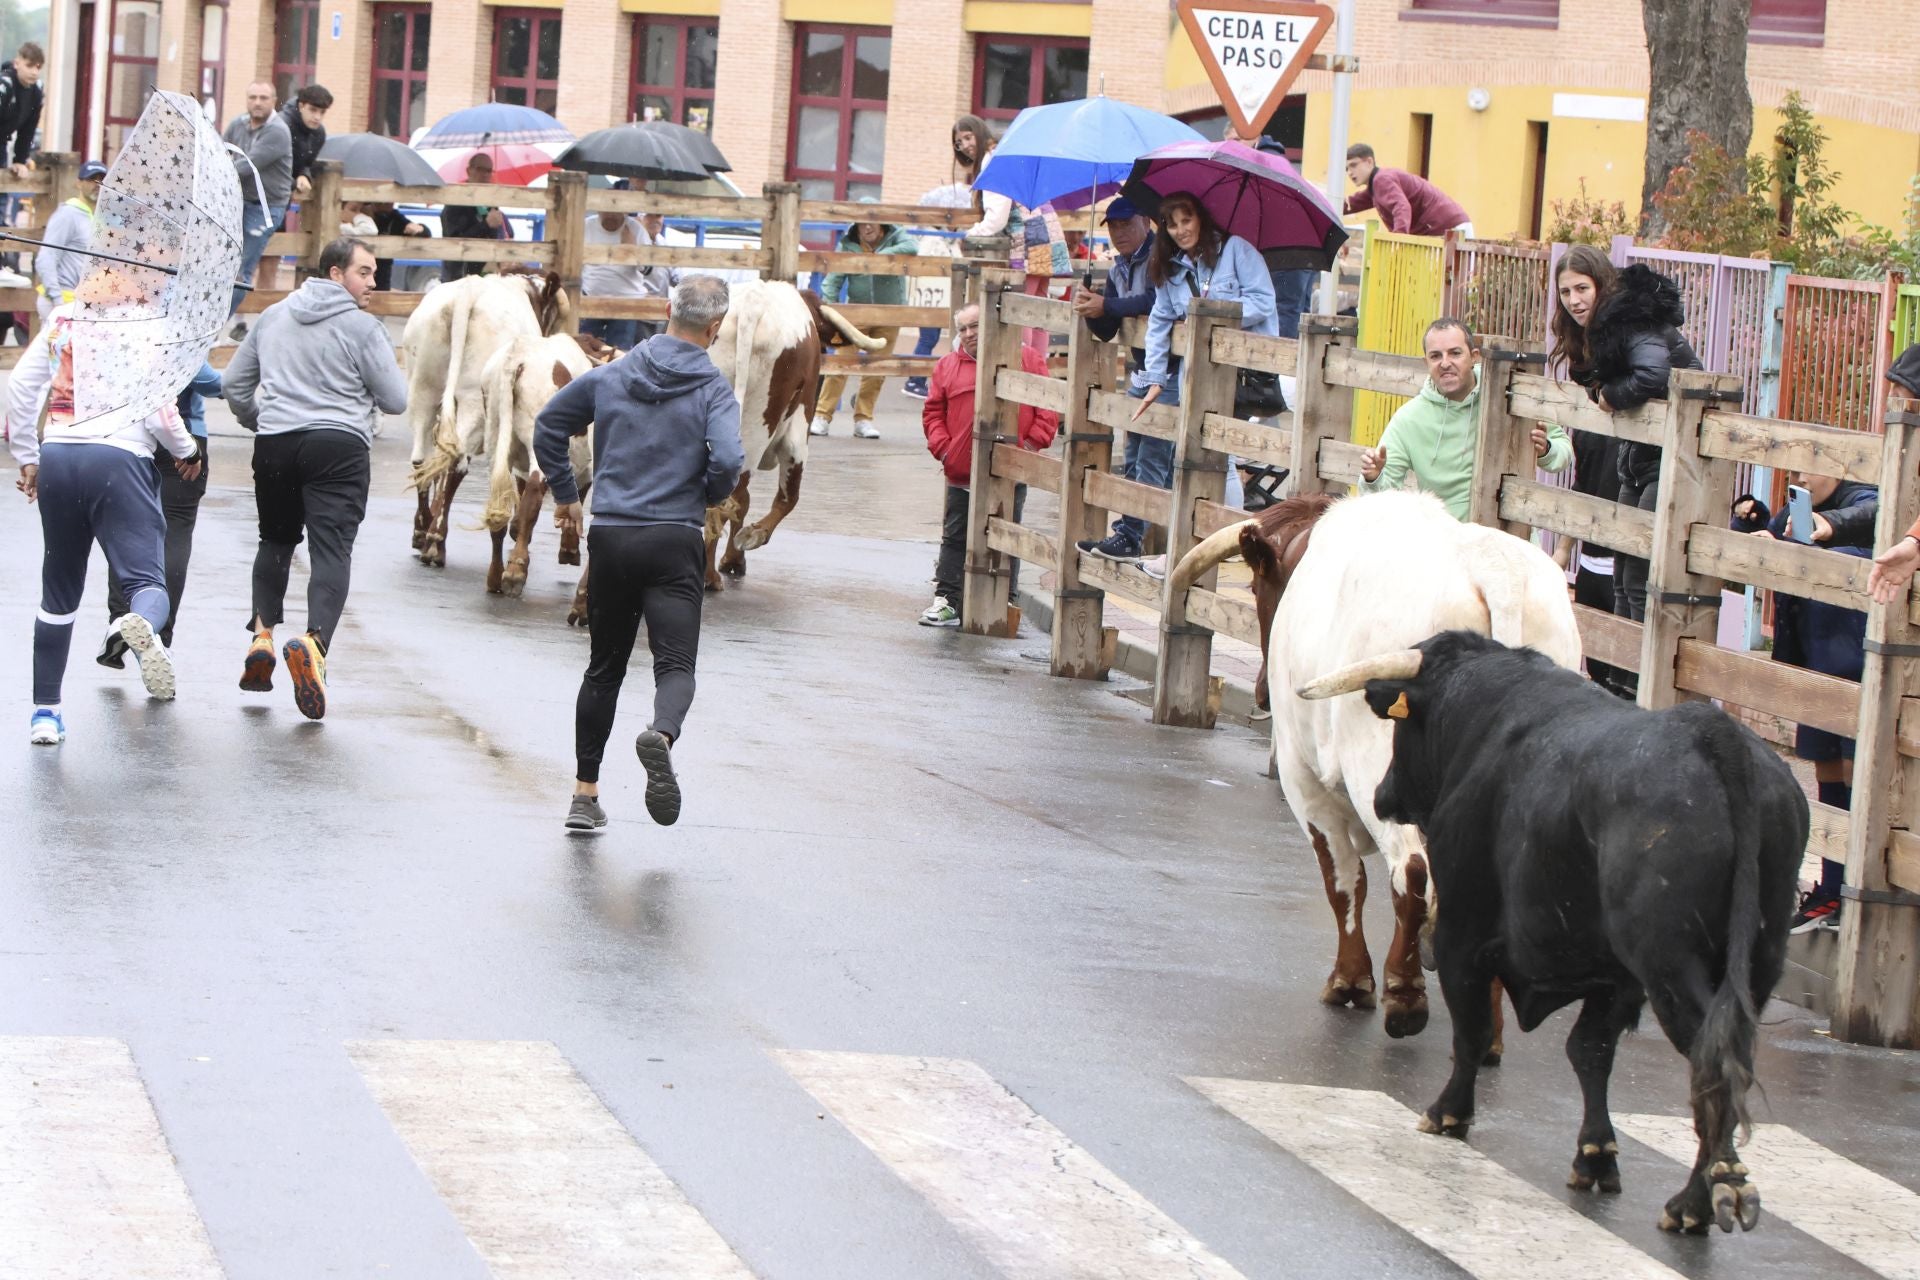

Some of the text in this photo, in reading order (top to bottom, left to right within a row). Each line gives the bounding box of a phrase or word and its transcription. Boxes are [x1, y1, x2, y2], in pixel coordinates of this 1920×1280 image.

[1208, 16, 1299, 43] CEDA EL
[1223, 45, 1283, 69] PASO
